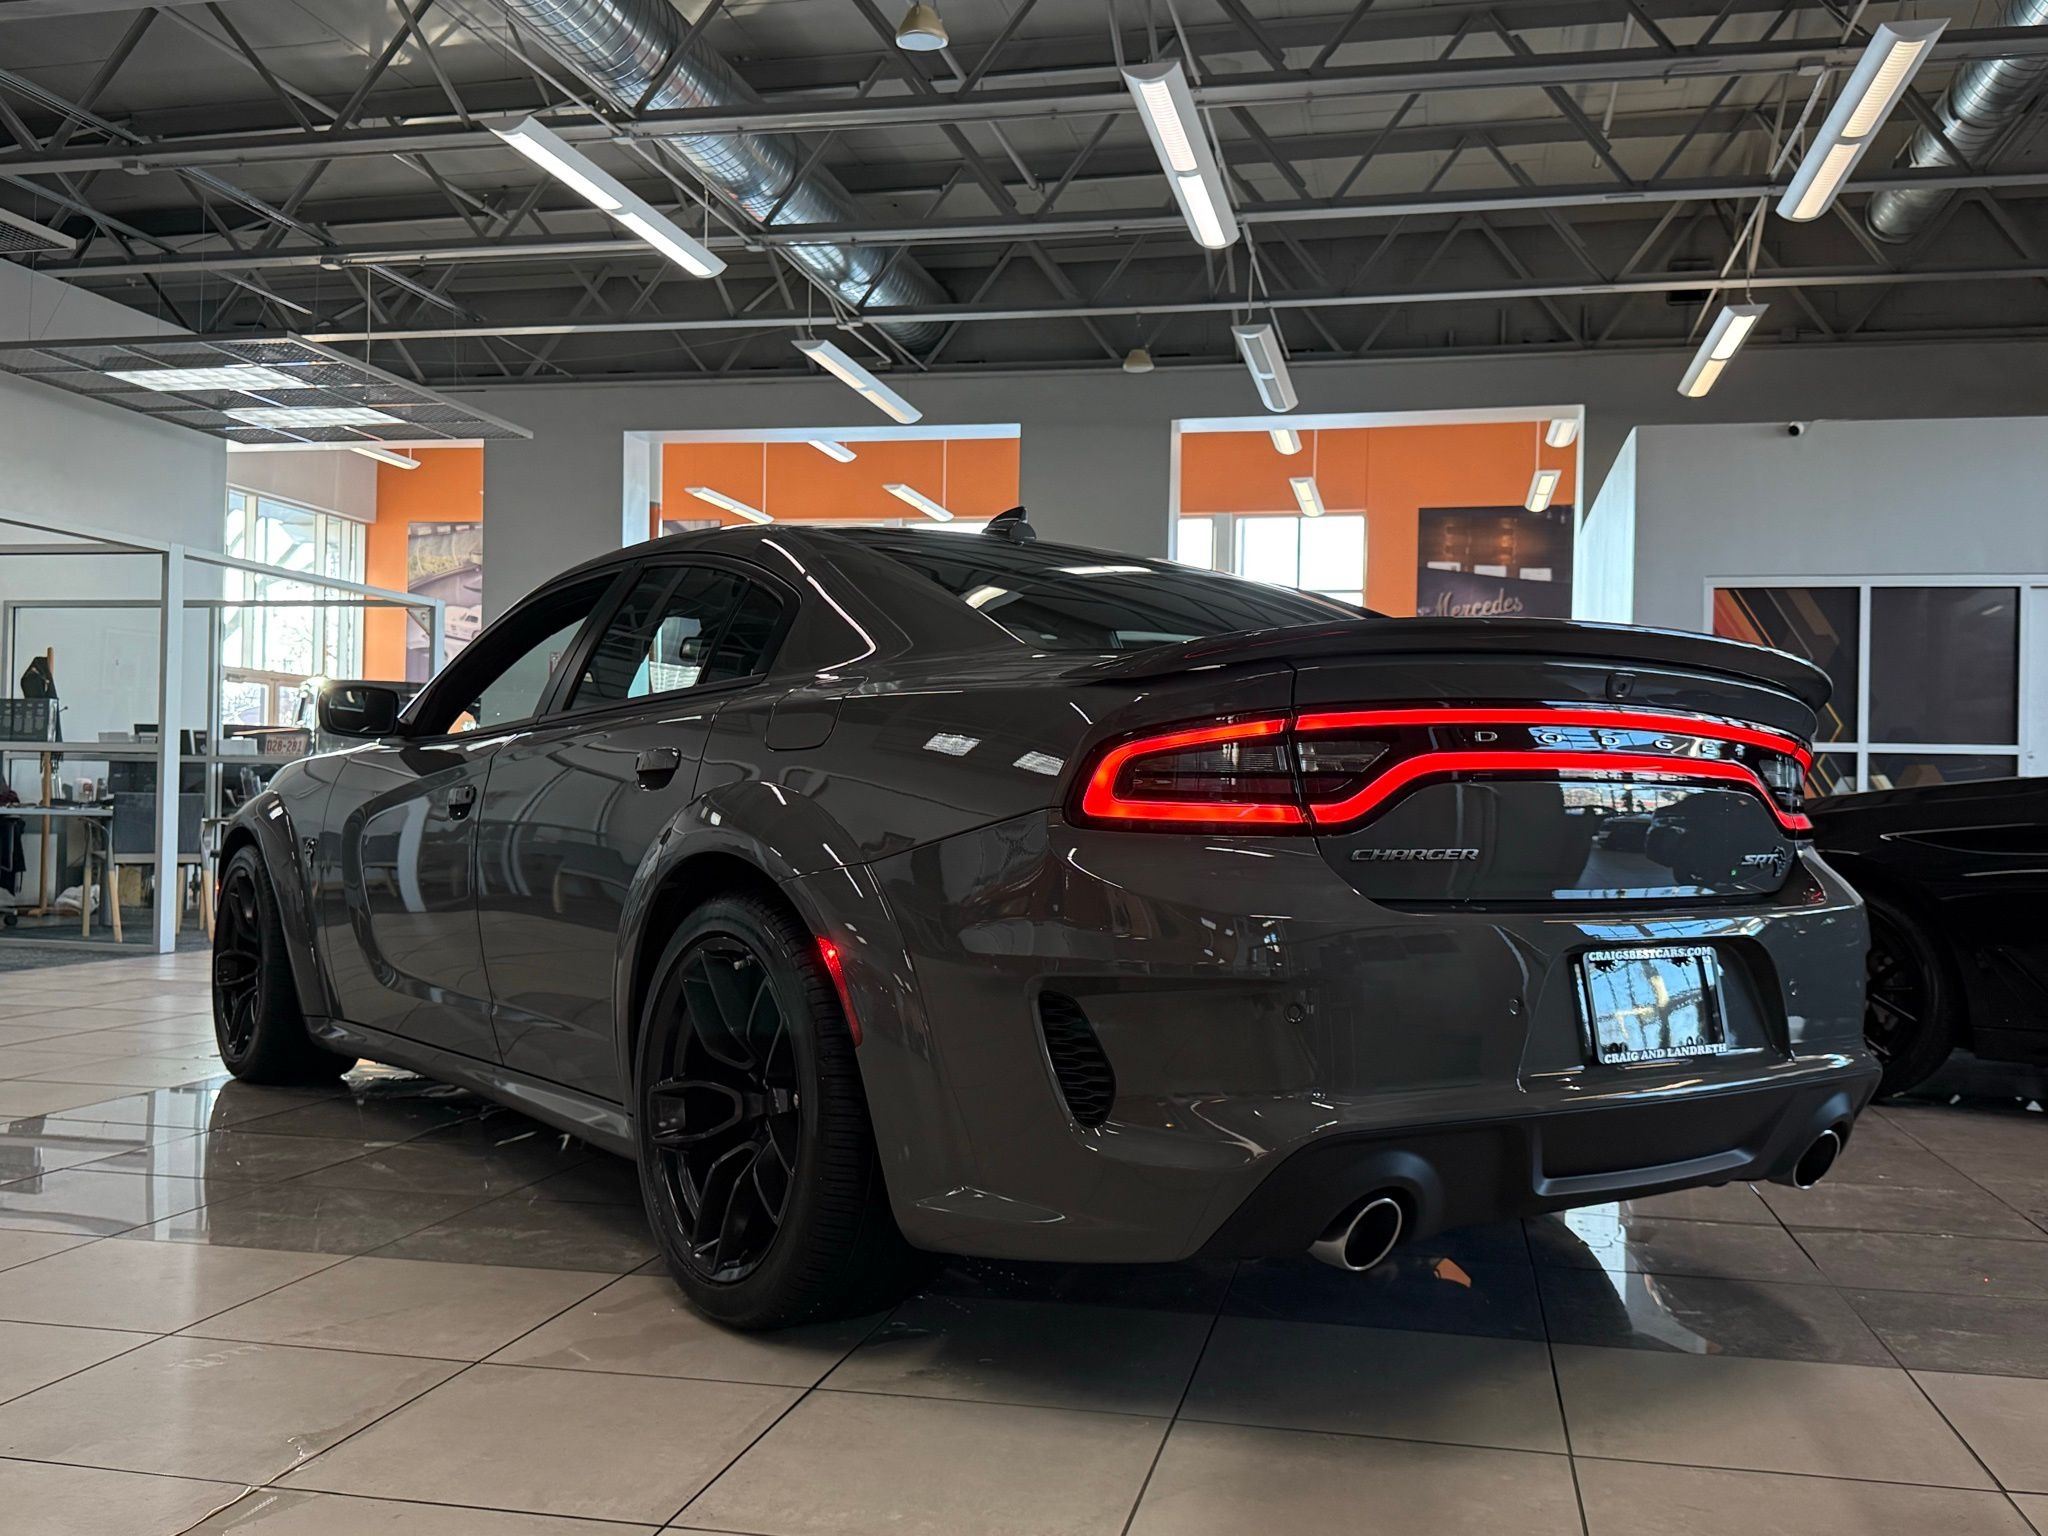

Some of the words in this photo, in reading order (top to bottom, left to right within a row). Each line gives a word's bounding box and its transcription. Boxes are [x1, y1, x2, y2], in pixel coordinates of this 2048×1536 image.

[1434, 588, 1524, 617] Mercedes
[1474, 730, 1720, 760] DODGE
[1351, 848, 1480, 861] CHARGER
[1741, 853, 1779, 865] SRT
[1588, 946, 1712, 961] CRAIGSBESTCARS.COM
[1604, 1052, 1639, 1064] CRAIG
[1640, 1048, 1665, 1060] AND
[1667, 1043, 1727, 1057] LANDRETH
